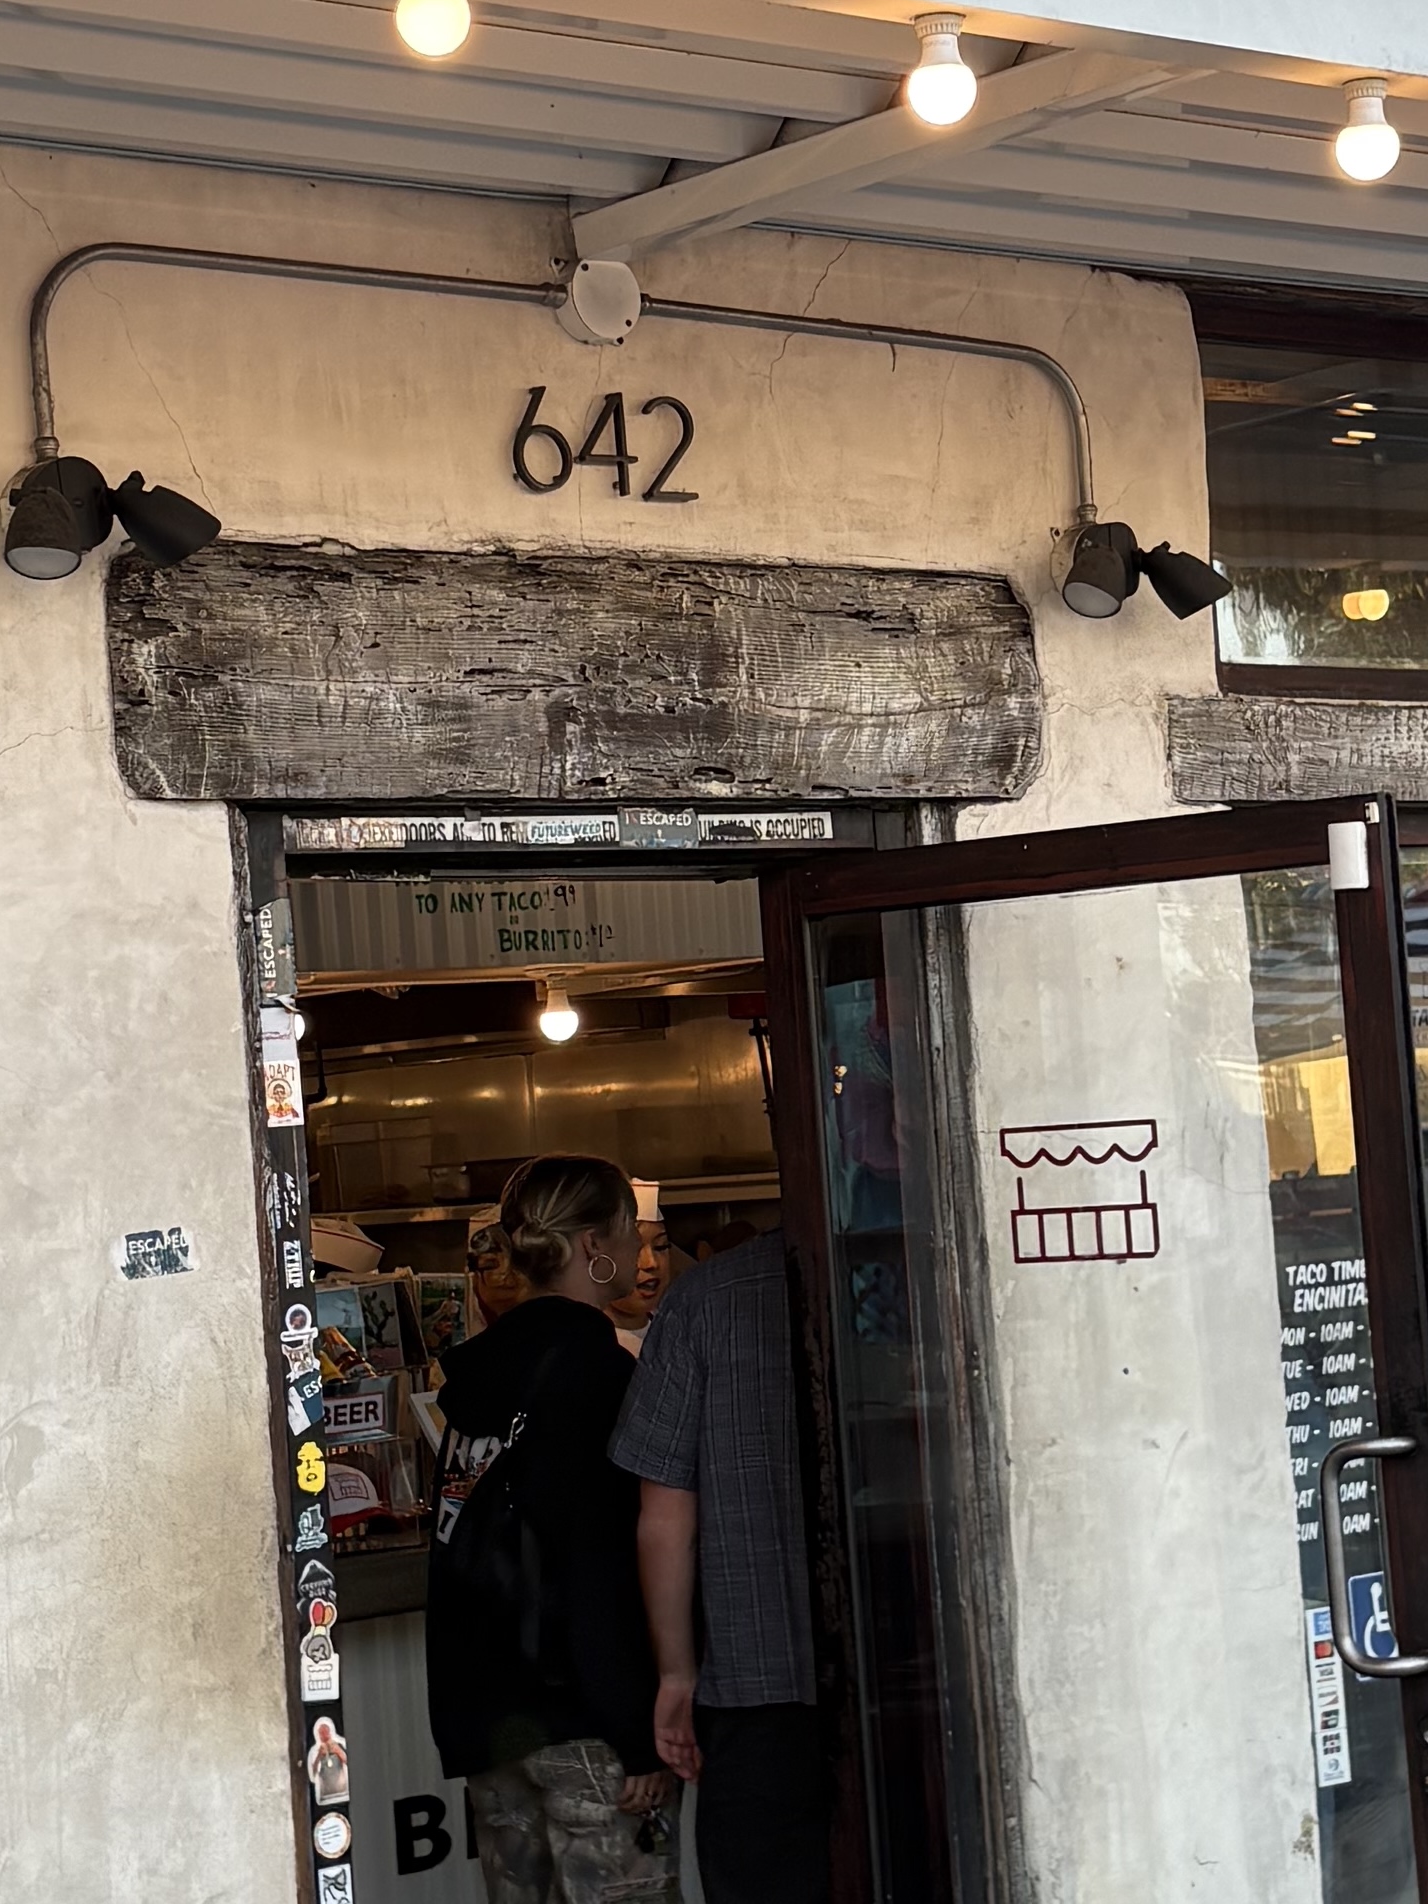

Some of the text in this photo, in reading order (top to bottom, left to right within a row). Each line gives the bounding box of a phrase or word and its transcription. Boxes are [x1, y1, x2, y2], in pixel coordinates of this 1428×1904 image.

[513, 385, 699, 503] 642
[640, 812, 692, 827] ESCAPED
[765, 816, 826, 839] OCCUPIED
[415, 893, 438, 914] TO
[450, 892, 485, 913] ANY
[260, 908, 276, 980] ESCAPED
[1286, 1263, 1327, 1287] TACO
[1293, 1282, 1368, 1312] ENCINITA
[1320, 1320, 1353, 1343] 10AM
[1322, 1352, 1355, 1375] 10AM
[1325, 1384, 1359, 1407] 10AM
[1329, 1416, 1362, 1439] 10AM
[1340, 1480, 1368, 1503] 0AM
[1342, 1513, 1370, 1535] 0AM
